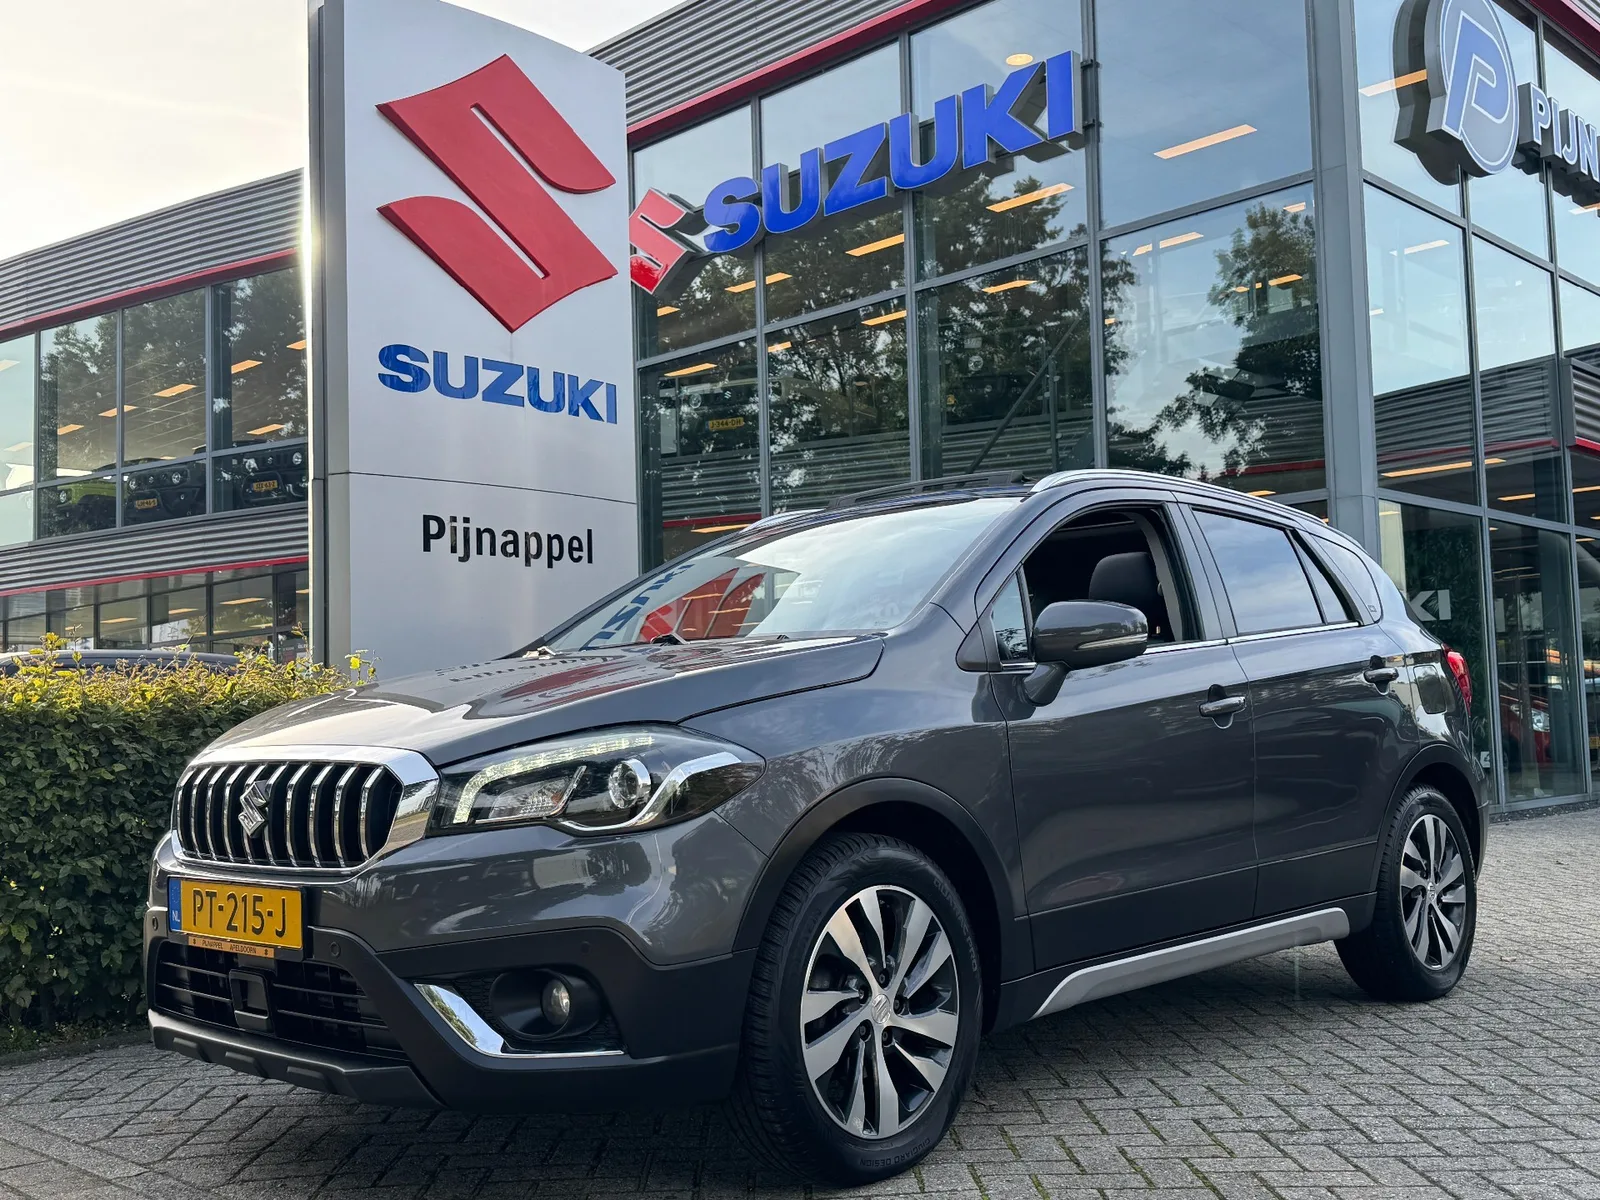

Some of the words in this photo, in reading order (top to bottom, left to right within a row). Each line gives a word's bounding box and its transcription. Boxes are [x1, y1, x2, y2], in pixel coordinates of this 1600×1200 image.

[703, 50, 1073, 253] SUZUKI
[378, 344, 618, 425] SUZUKI
[422, 514, 594, 569] Pijnappel
[172, 911, 181, 923] NL
[192, 888, 287, 938] PT-215-J
[859, 1158, 892, 1167] DESIGN
